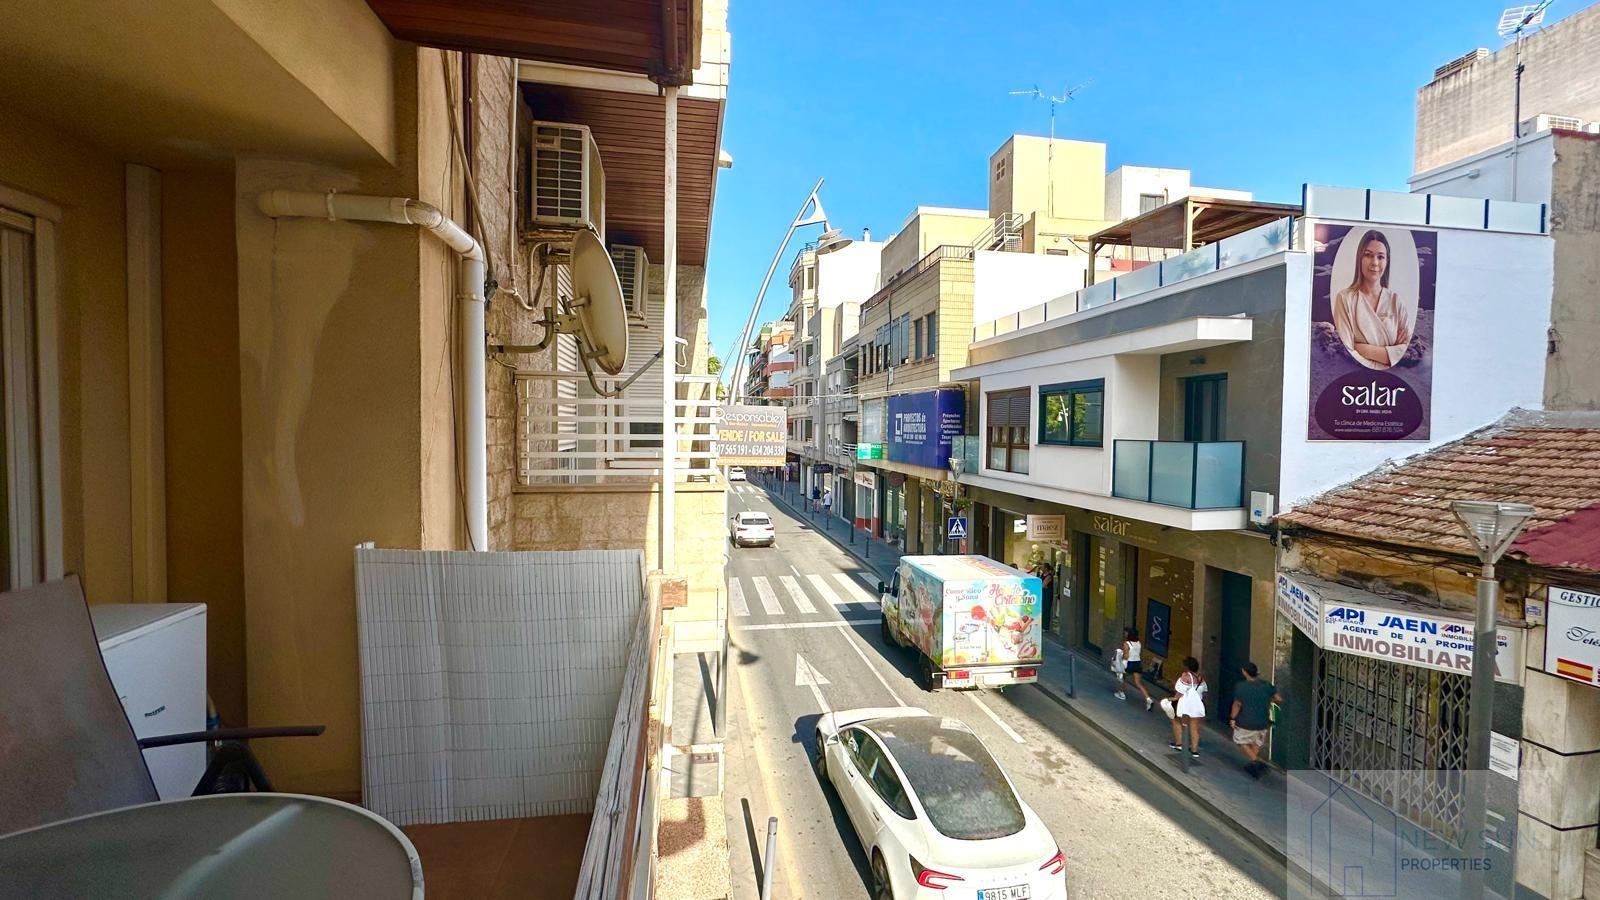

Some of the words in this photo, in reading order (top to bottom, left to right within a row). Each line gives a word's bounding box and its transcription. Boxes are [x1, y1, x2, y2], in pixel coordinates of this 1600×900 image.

[1341, 381, 1405, 406] salar
[749, 430, 765, 442] FOR
[766, 431, 785, 443] SALE
[725, 444, 737, 455] 565
[737, 444, 748, 455] 191
[752, 446, 763, 456] 634
[1093, 515, 1131, 536] salar
[1290, 584, 1304, 603] JAEN
[1328, 607, 1365, 623] API
[1378, 615, 1437, 635] JAEN
[1441, 624, 1465, 634] API
[1343, 625, 1379, 636] AGENTE
[1390, 632, 1404, 640] DE
[1333, 632, 1501, 676] INMOBILIAR
[985, 890, 1008, 900] 9815
[1010, 887, 1027, 898] MLF
